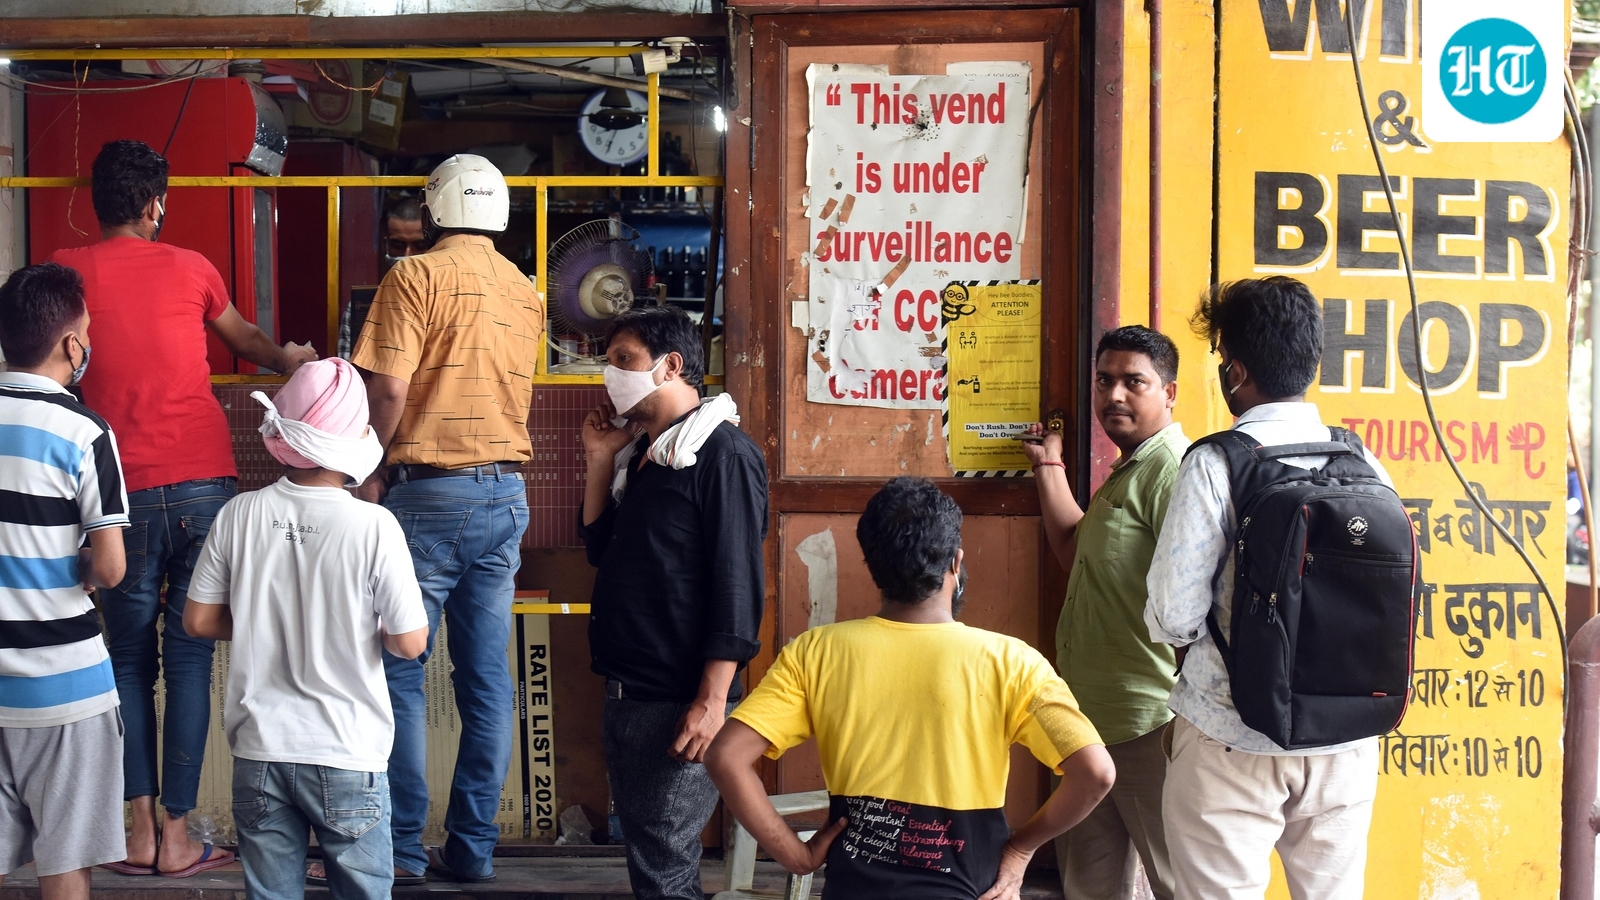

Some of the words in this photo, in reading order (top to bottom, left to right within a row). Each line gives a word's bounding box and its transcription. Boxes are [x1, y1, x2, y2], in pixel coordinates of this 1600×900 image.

[1257, 0, 1422, 60] WI
[850, 82, 919, 125] This
[929, 82, 1006, 125] vend
[1372, 90, 1432, 151] &
[618, 146, 625, 156] 6
[629, 141, 636, 151] 5
[856, 151, 882, 194] is
[893, 152, 987, 194] under
[817, 220, 1013, 264] surveillance
[1254, 171, 1556, 280] BEER
[894, 289, 944, 332] CC
[1319, 298, 1551, 398] HOP
[1342, 418, 1498, 464] TOURISM
[1454, 482, 1551, 559] बीयर
[1444, 582, 1546, 658] दुकान
[530, 644, 548, 706] RATE
[1492, 675, 1516, 702] से
[1518, 669, 1544, 706] 10
[533, 715, 550, 768] LIST
[1494, 738, 1510, 772] से
[1514, 736, 1542, 778] 10
[863, 812, 905, 827] important
[864, 798, 887, 812] good
[887, 801, 912, 815] Great
[908, 819, 952, 832] Essential
[861, 849, 898, 864] expensive
[863, 832, 897, 854] cheerful
[899, 845, 943, 859] Hilarious
[901, 832, 965, 852] Extraordinary
